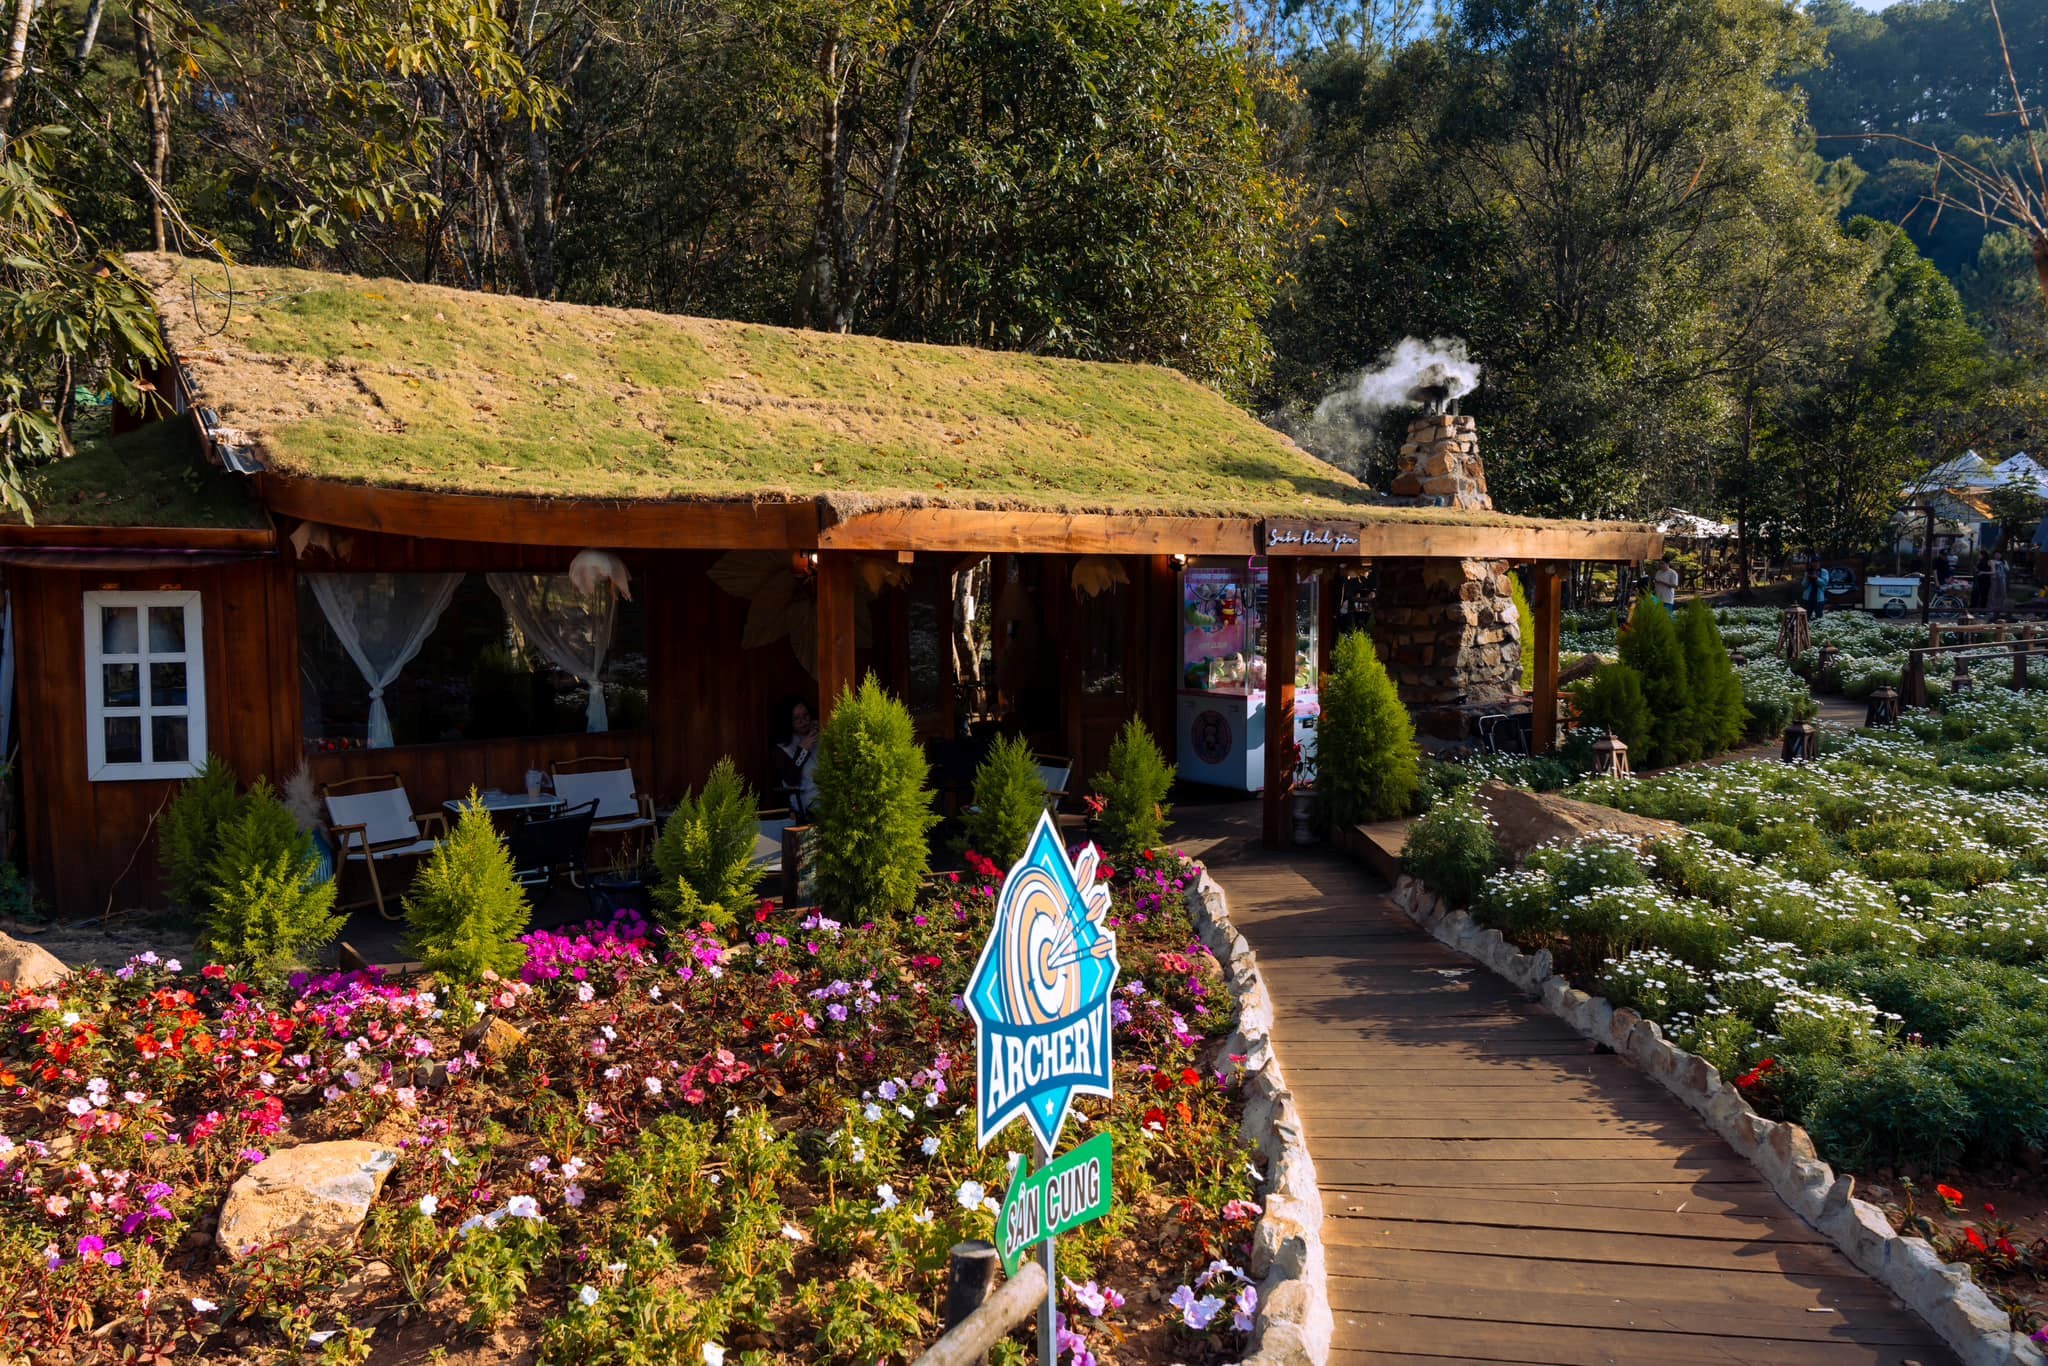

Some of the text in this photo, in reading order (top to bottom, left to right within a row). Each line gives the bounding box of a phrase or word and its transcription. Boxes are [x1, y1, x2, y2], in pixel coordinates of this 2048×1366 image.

[986, 1003, 1105, 1120] ARCHERY
[1005, 1157, 1100, 1258] SÂN CUNG
